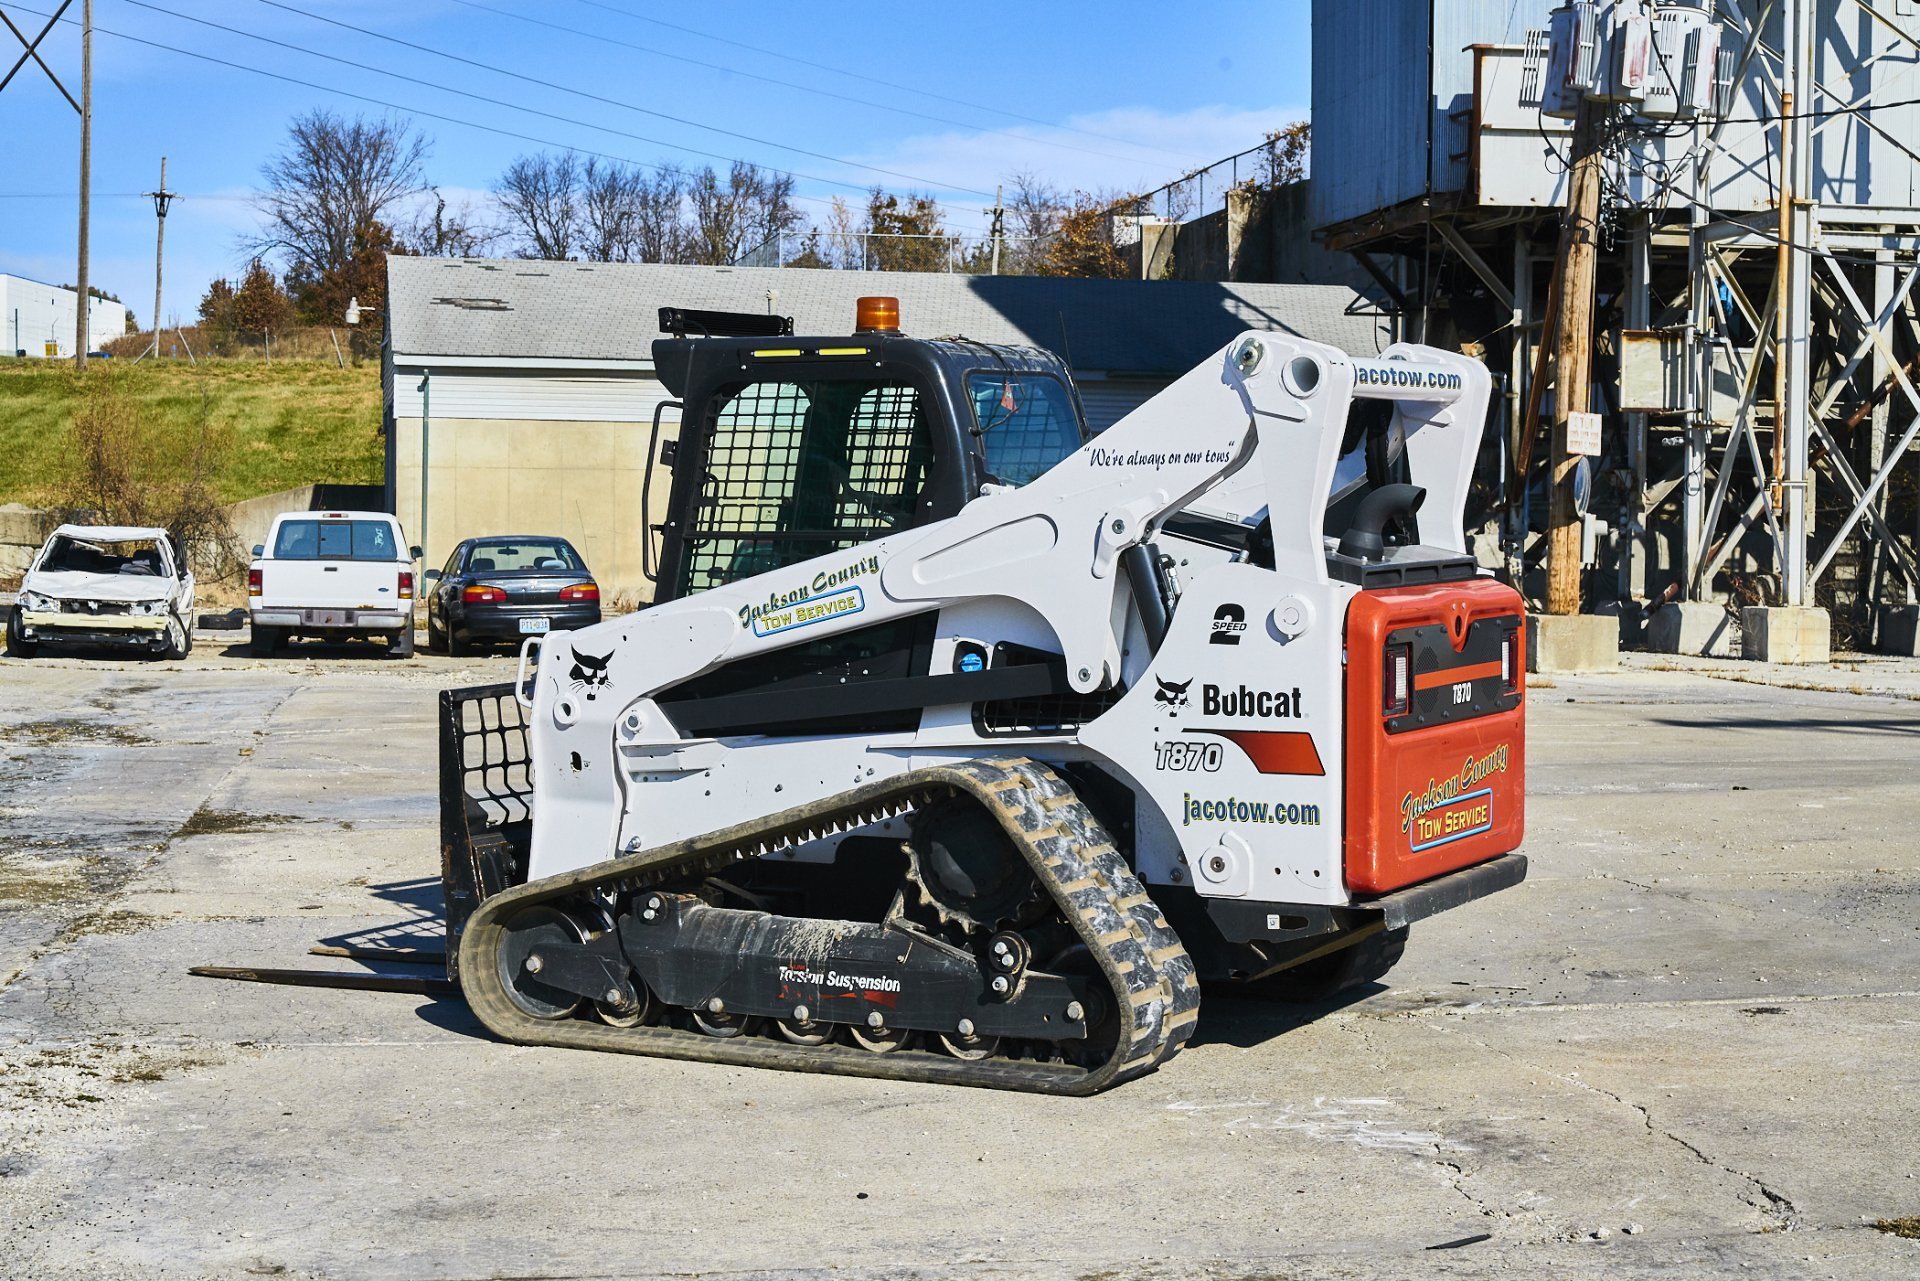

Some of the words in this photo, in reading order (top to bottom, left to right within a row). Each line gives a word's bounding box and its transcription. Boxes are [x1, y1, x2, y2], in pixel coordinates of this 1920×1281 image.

[1127, 450, 1165, 471] always
[1168, 453, 1181, 464] on
[1184, 451, 1202, 464] our
[739, 586, 810, 629] Jackson
[812, 555, 880, 593] County
[762, 612, 792, 631] TOW
[796, 596, 857, 622] SERVICE
[1209, 603, 1246, 645] 2
[1212, 621, 1248, 631] SPEED
[1203, 684, 1302, 718] Bobcat
[1453, 682, 1472, 704] T870
[1155, 741, 1224, 772] T870
[1401, 775, 1460, 834] Jackson
[1461, 744, 1509, 791] County
[1183, 792, 1321, 826] jacotow.com
[1418, 815, 1442, 841] TOW
[1445, 804, 1488, 834] SERVICE
[826, 970, 901, 992] Suspension
